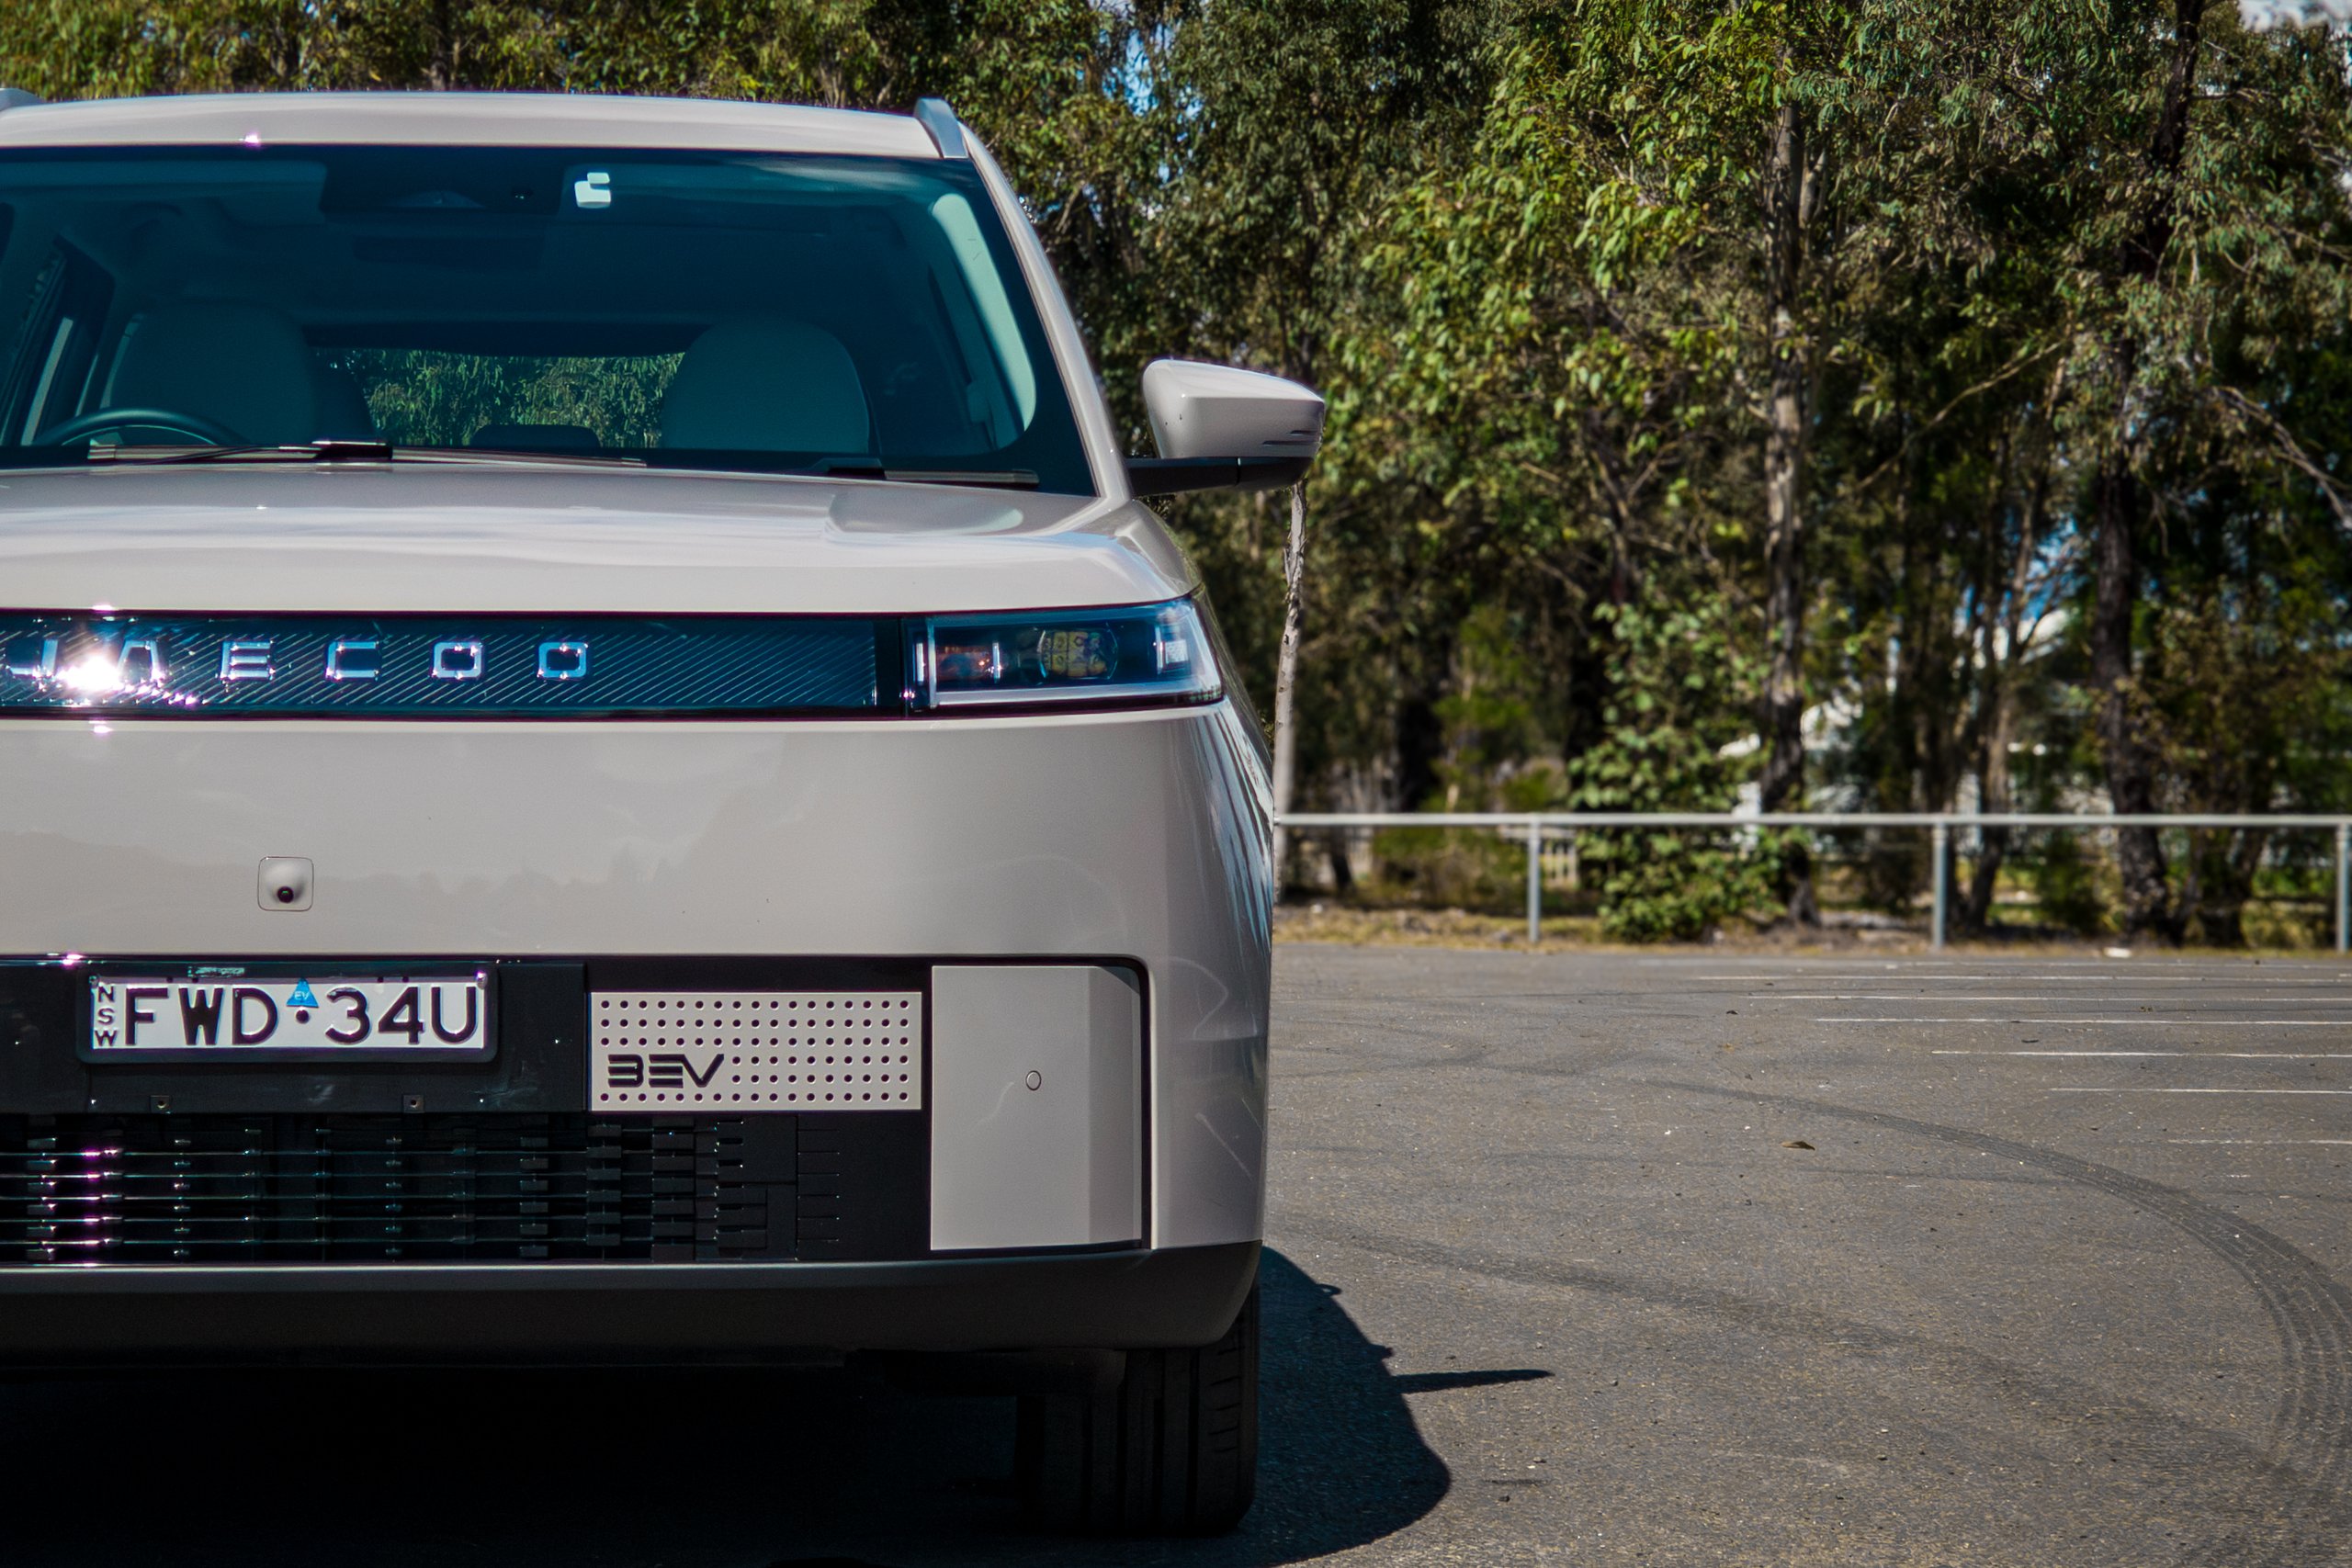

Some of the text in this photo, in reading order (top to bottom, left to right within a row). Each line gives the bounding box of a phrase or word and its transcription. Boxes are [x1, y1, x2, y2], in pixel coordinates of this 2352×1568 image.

[6, 637, 588, 681] JAECOO
[95, 983, 113, 1046] NSW
[294, 990, 310, 1000] EV
[607, 1053, 725, 1089] BEV
